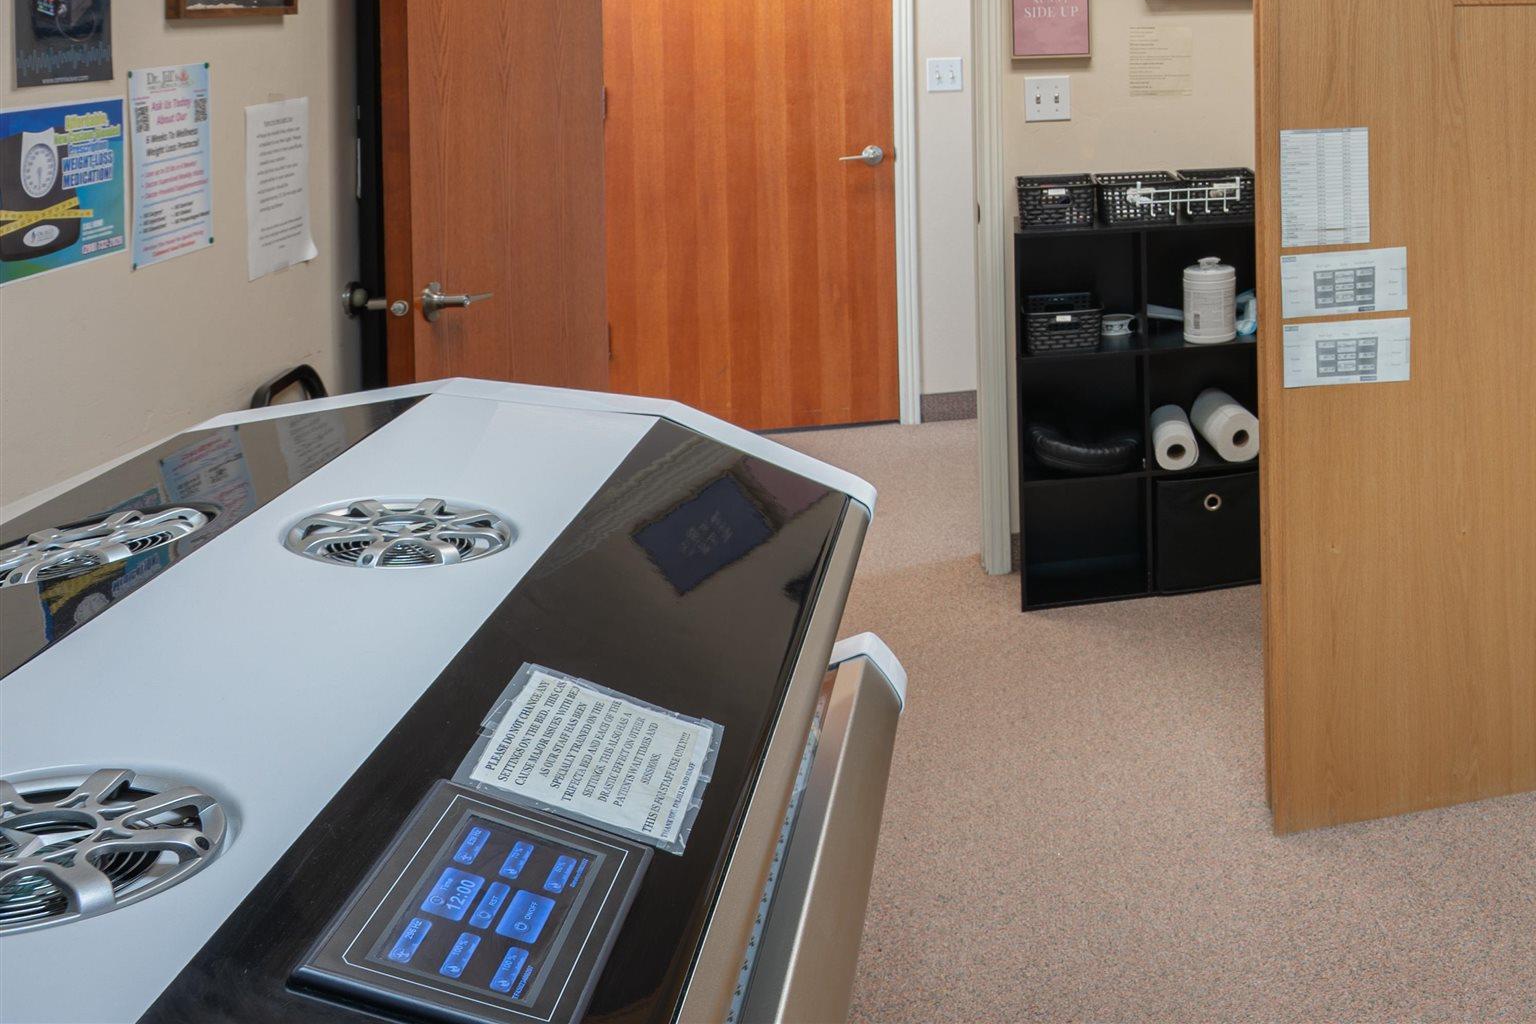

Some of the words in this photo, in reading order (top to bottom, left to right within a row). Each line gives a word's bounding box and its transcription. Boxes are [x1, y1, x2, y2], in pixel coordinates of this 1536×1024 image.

[1025, 6, 1054, 17] SIDE
[1061, 6, 1079, 17] UP
[572, 702, 586, 718] BEEN
[591, 701, 604, 714] THE
[608, 701, 621, 713] THE
[485, 744, 508, 770] PLEASE
[502, 733, 515, 744] DO
[509, 719, 524, 733] NOT
[519, 694, 541, 719] CHANGE
[537, 680, 549, 693] ANY
[564, 719, 578, 732] HAS
[587, 715, 596, 724] ON
[604, 713, 614, 722] OF
[498, 748, 524, 781] SETTINGS
[519, 737, 531, 748] ON
[525, 723, 540, 736] THE
[534, 710, 549, 723] BED.
[544, 693, 559, 707] THIS
[570, 724, 591, 752] TRAINED
[595, 722, 610, 740] EACH
[515, 762, 534, 785] CAUSE
[528, 738, 549, 762] MAJOR
[543, 716, 562, 738] ISSUES
[556, 698, 572, 715] WITH
[553, 732, 569, 753] STAFF
[588, 740, 600, 754] AND
[599, 747, 613, 763] THIS
[608, 731, 622, 748] ALSO
[616, 718, 628, 731] HAS
[544, 753, 558, 767] OUR
[579, 754, 592, 768] BED
[598, 774, 618, 802] DRASTIC
[612, 749, 629, 773] EFFECT
[624, 738, 634, 749] ON
[629, 717, 645, 738] OTHER
[613, 774, 634, 806] PATIENTS
[628, 756, 642, 773] WAIT
[636, 737, 651, 755] TIMES
[646, 723, 658, 737] AND
[539, 768, 550, 777] AS
[550, 755, 575, 788] SPECIALLY
[641, 754, 661, 784] SESSIONS.
[561, 769, 585, 800] TRIFECTA
[642, 812, 657, 831] THIS
[651, 804, 660, 812] IS
[659, 771, 674, 791] STAFF
[668, 757, 680, 770] USE
[447, 880, 475, 909] 12:00
[489, 895, 497, 906] RST
[524, 902, 536, 919] ON/OFF
